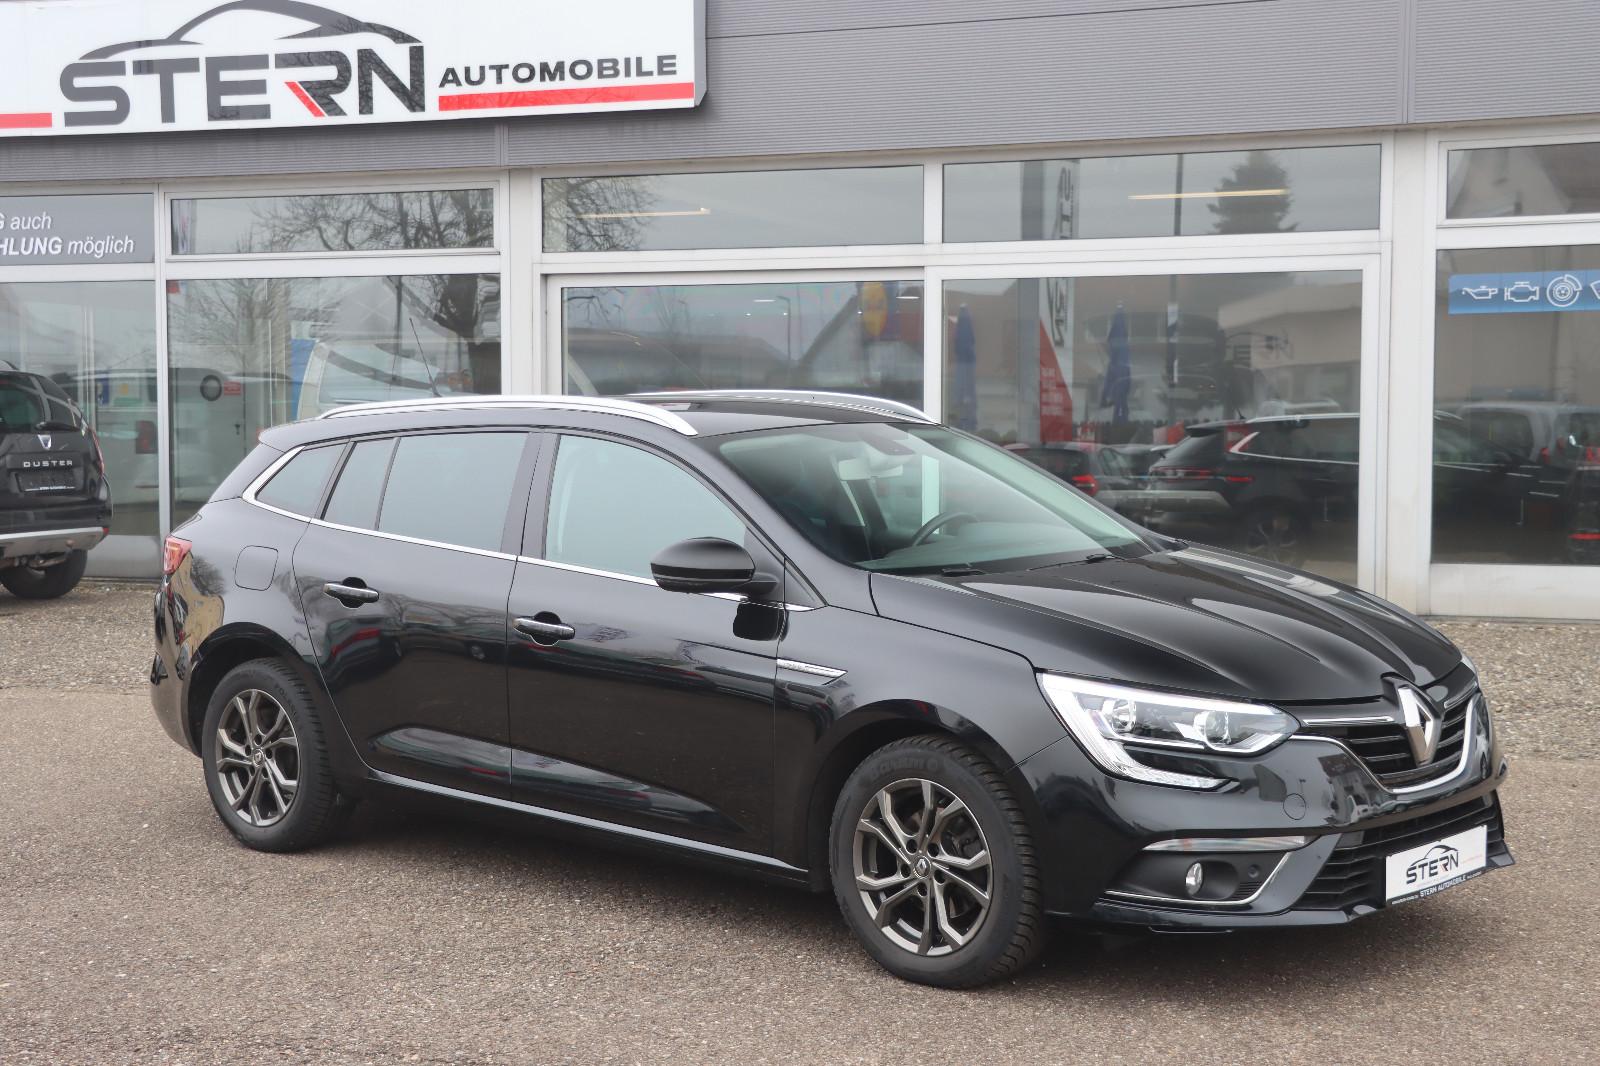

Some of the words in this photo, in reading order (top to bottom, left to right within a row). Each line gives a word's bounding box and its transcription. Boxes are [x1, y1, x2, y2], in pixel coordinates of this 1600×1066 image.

[59, 45, 424, 127] STERN
[438, 54, 678, 89] AUTOMOBILE
[10, 211, 52, 231] auch
[67, 235, 135, 258] möglich
[23, 459, 73, 468] DUSTER
[1406, 852, 1459, 884] STERN
[1419, 886, 1438, 898] STERN
[1437, 875, 1467, 892] AUTOMOBILE
